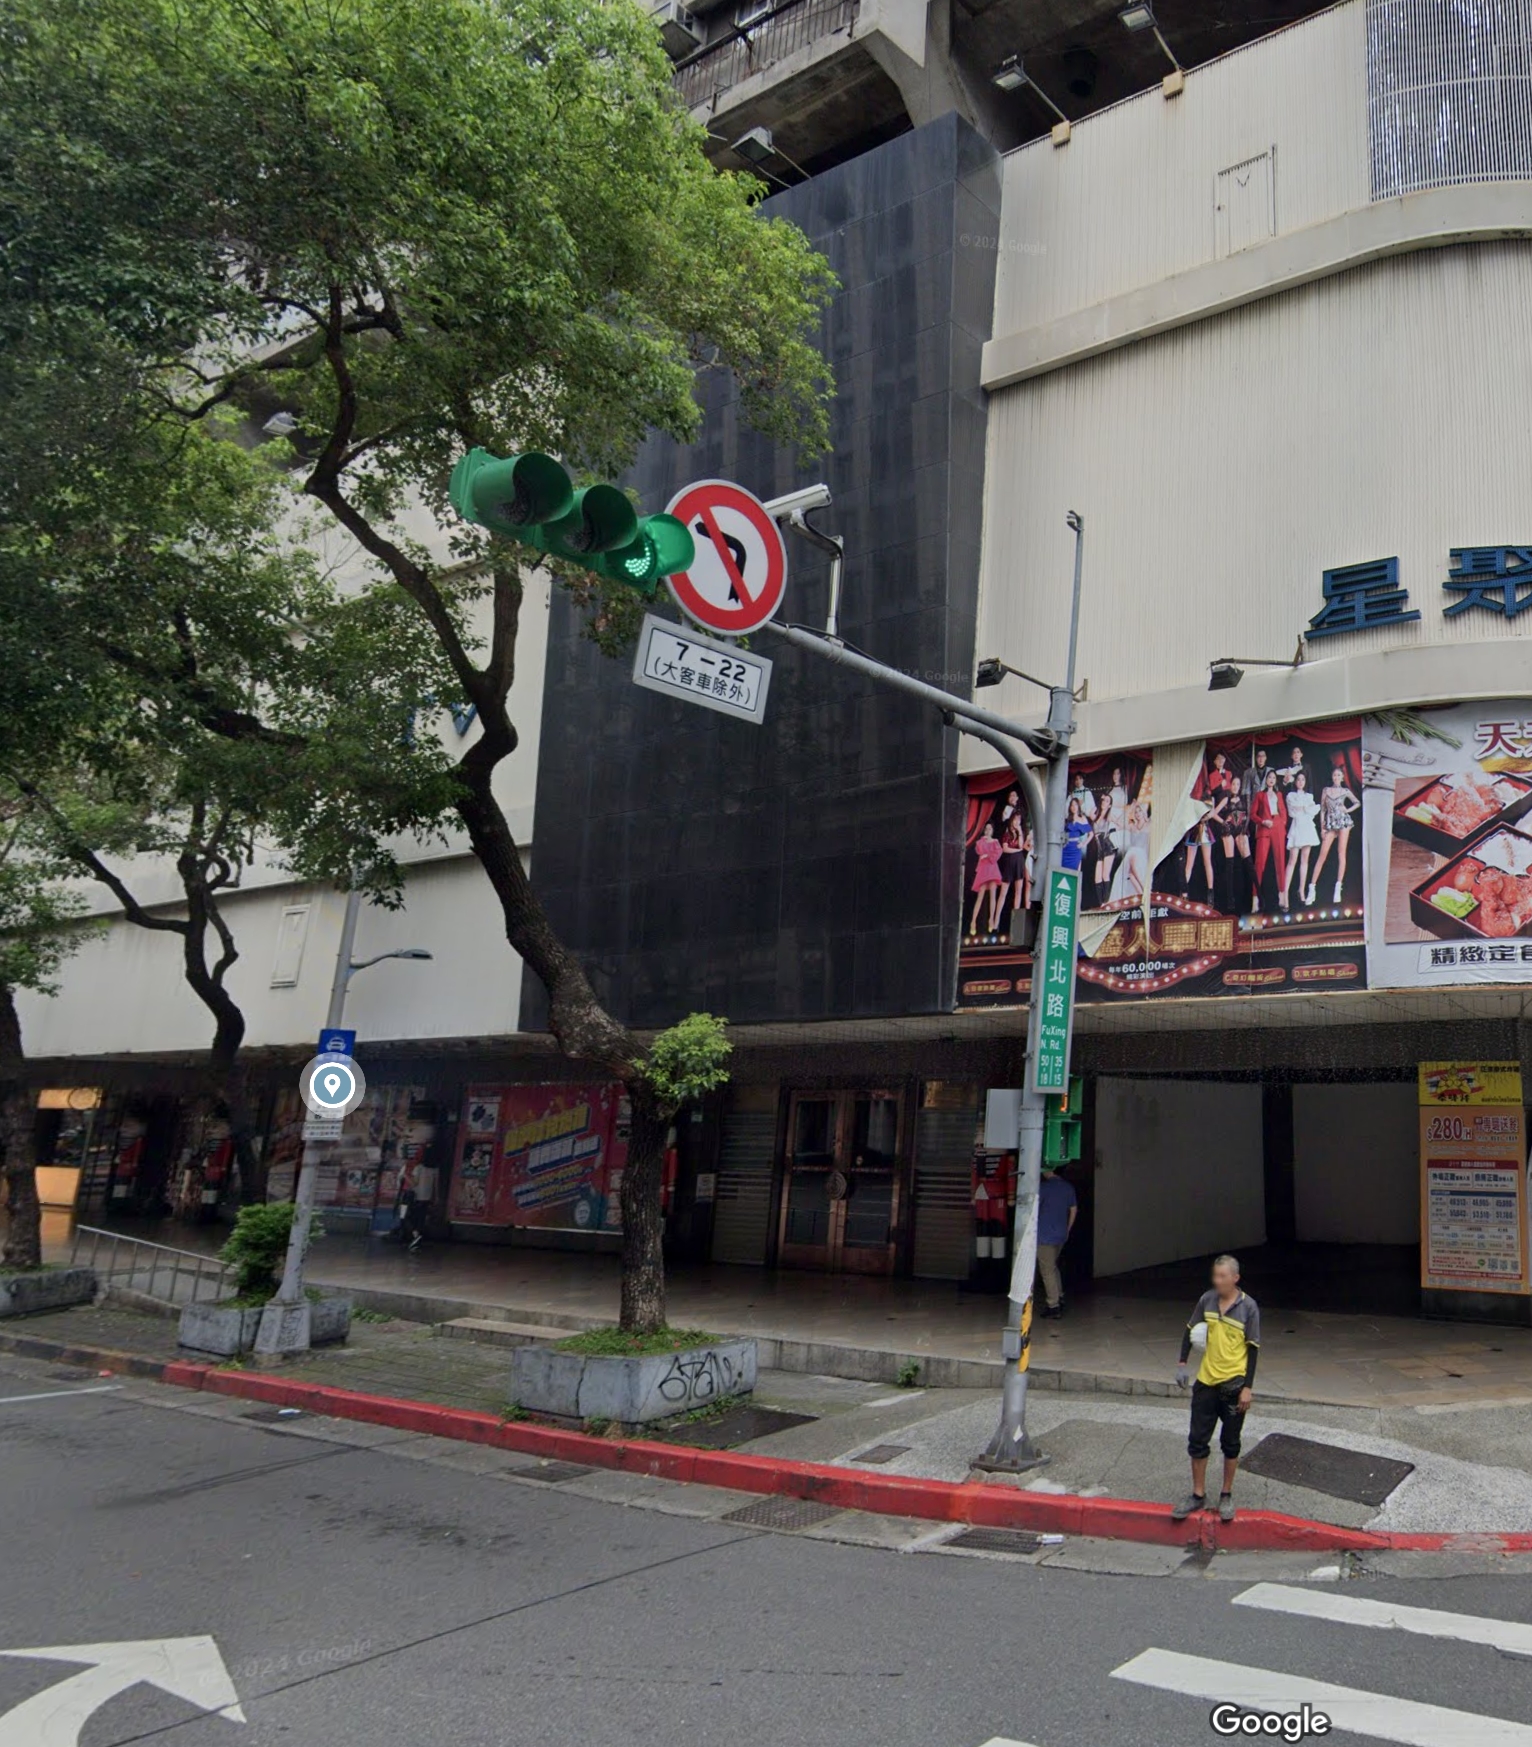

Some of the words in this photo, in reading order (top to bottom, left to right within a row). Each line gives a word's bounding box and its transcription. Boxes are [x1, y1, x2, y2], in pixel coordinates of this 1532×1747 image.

[653, 656, 751, 704] (大客車除外)
[1046, 893, 1071, 1017] 復興北路
[1041, 1024, 1066, 1040] FuXing
[1040, 1039, 1047, 1049] N.
[1050, 1039, 1061, 1050] Rd.
[1041, 1055, 1049, 1066] 50
[1054, 1056, 1063, 1067] 35
[1041, 1073, 1048, 1085] 18
[1054, 1073, 1062, 1085] 15
